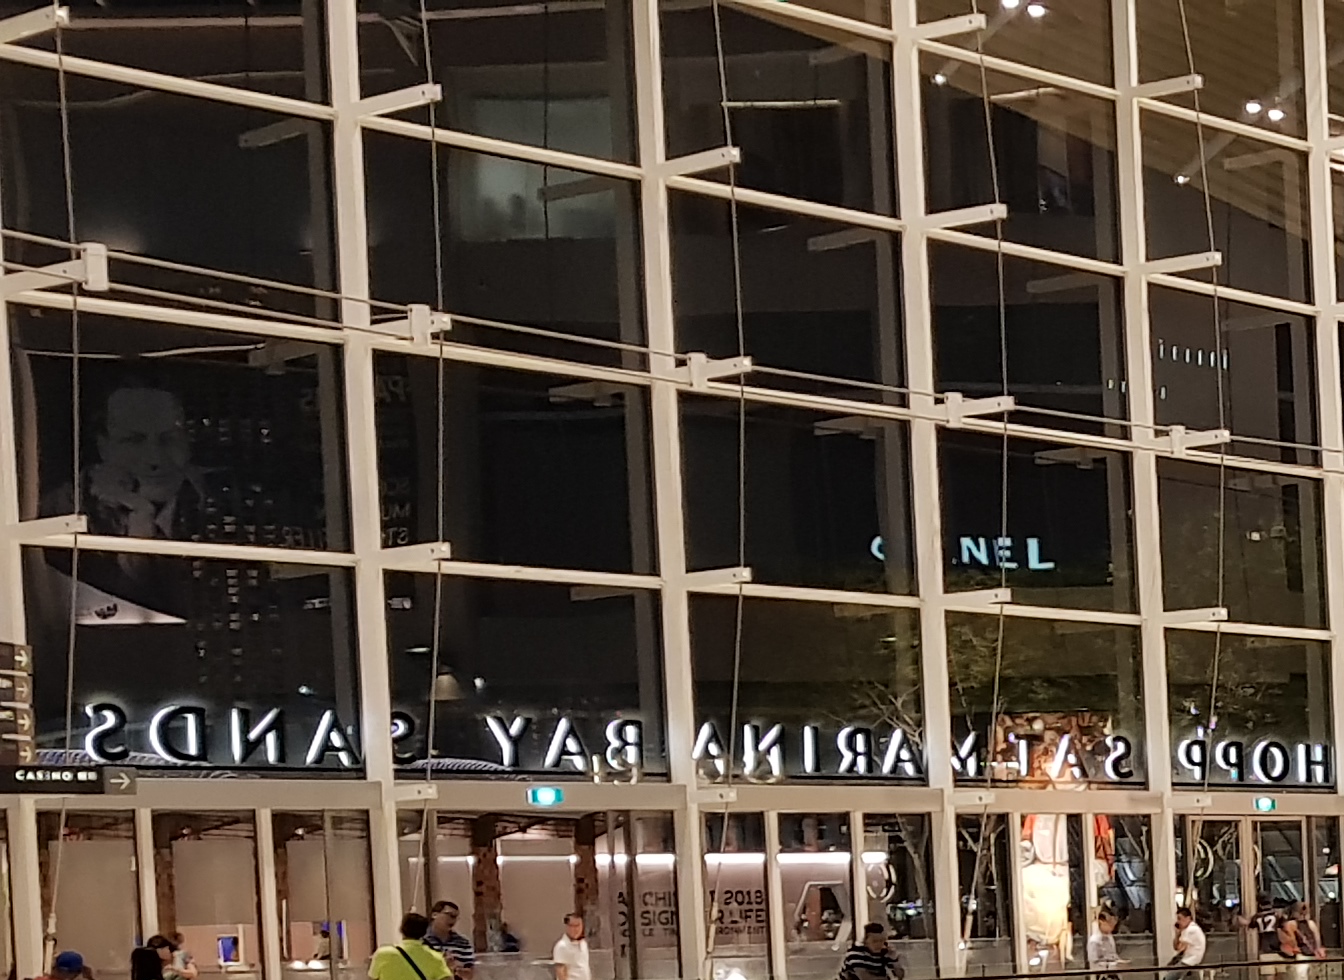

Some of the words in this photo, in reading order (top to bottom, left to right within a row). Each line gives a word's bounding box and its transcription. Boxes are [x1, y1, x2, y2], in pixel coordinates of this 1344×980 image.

[15, 769, 74, 782] CASINO
[724, 889, 765, 906] 2018
[1256, 915, 1277, 933] 12
